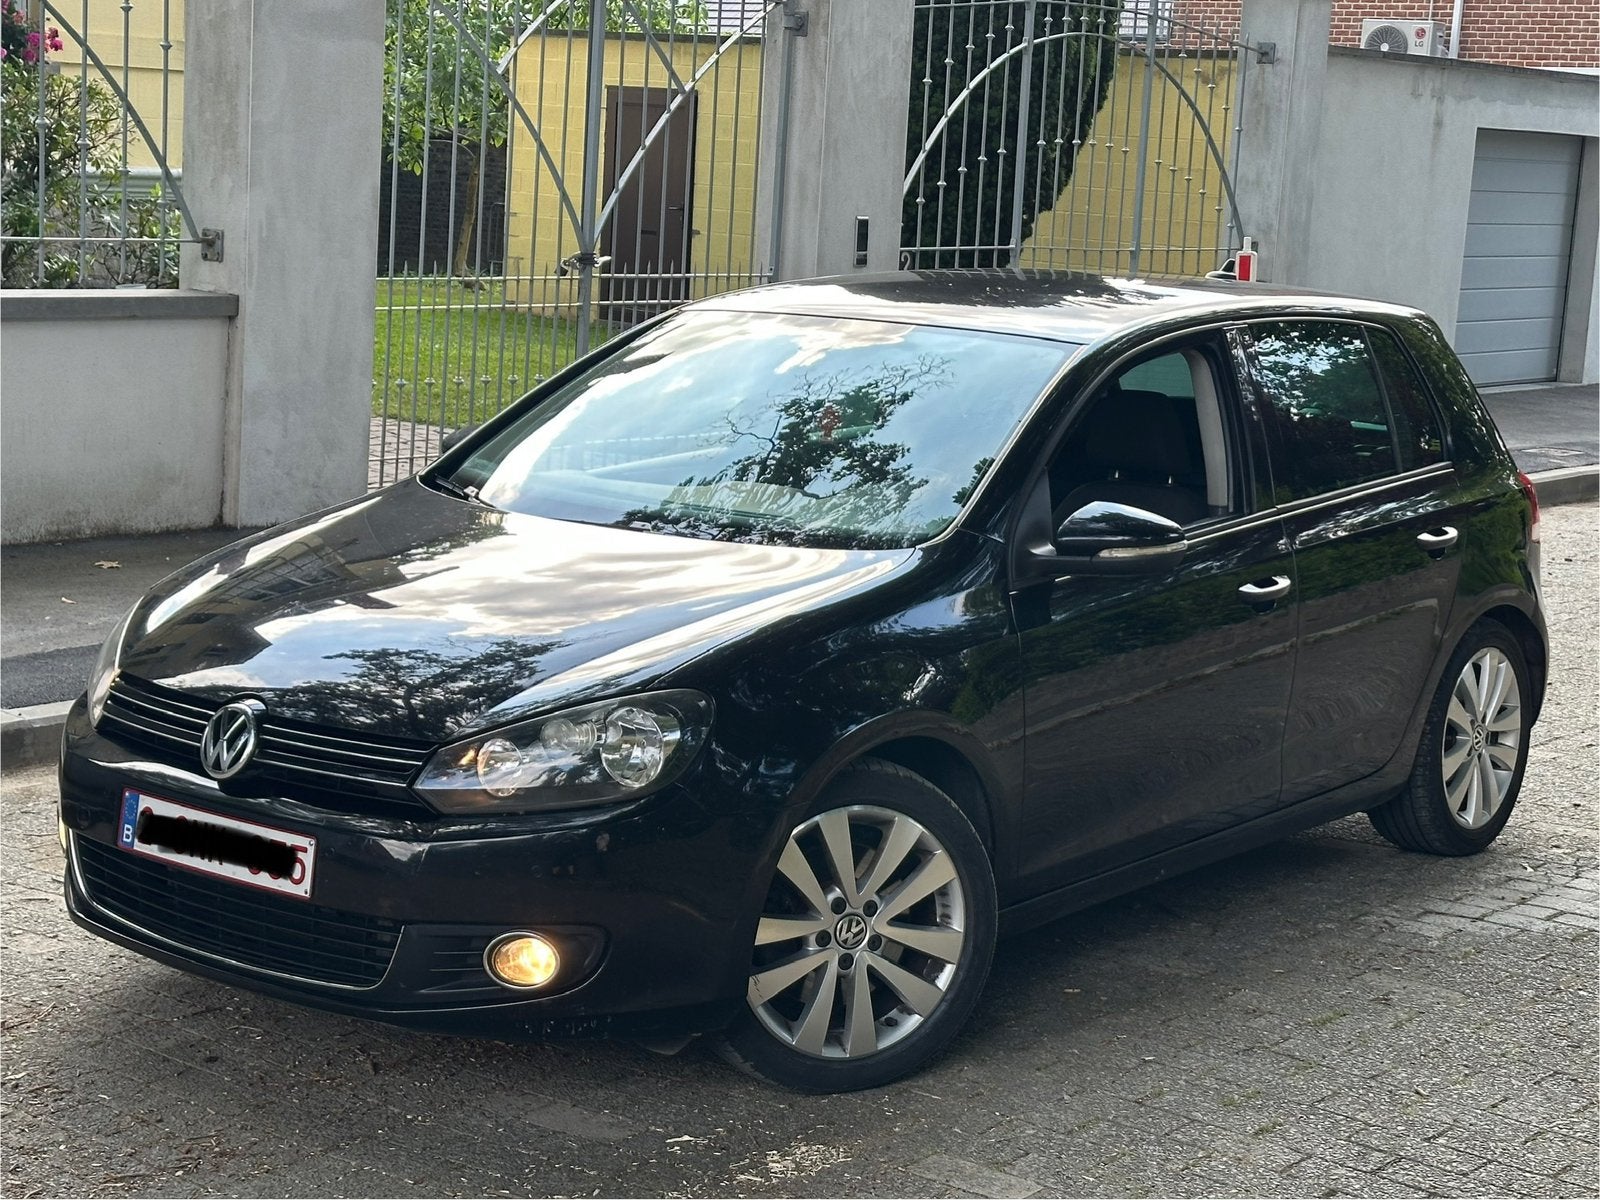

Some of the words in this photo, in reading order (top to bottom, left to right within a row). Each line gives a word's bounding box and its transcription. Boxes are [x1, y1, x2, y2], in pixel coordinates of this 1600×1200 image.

[203, 705, 253, 776] VW
[123, 824, 133, 842] B
[837, 915, 866, 947] VW
